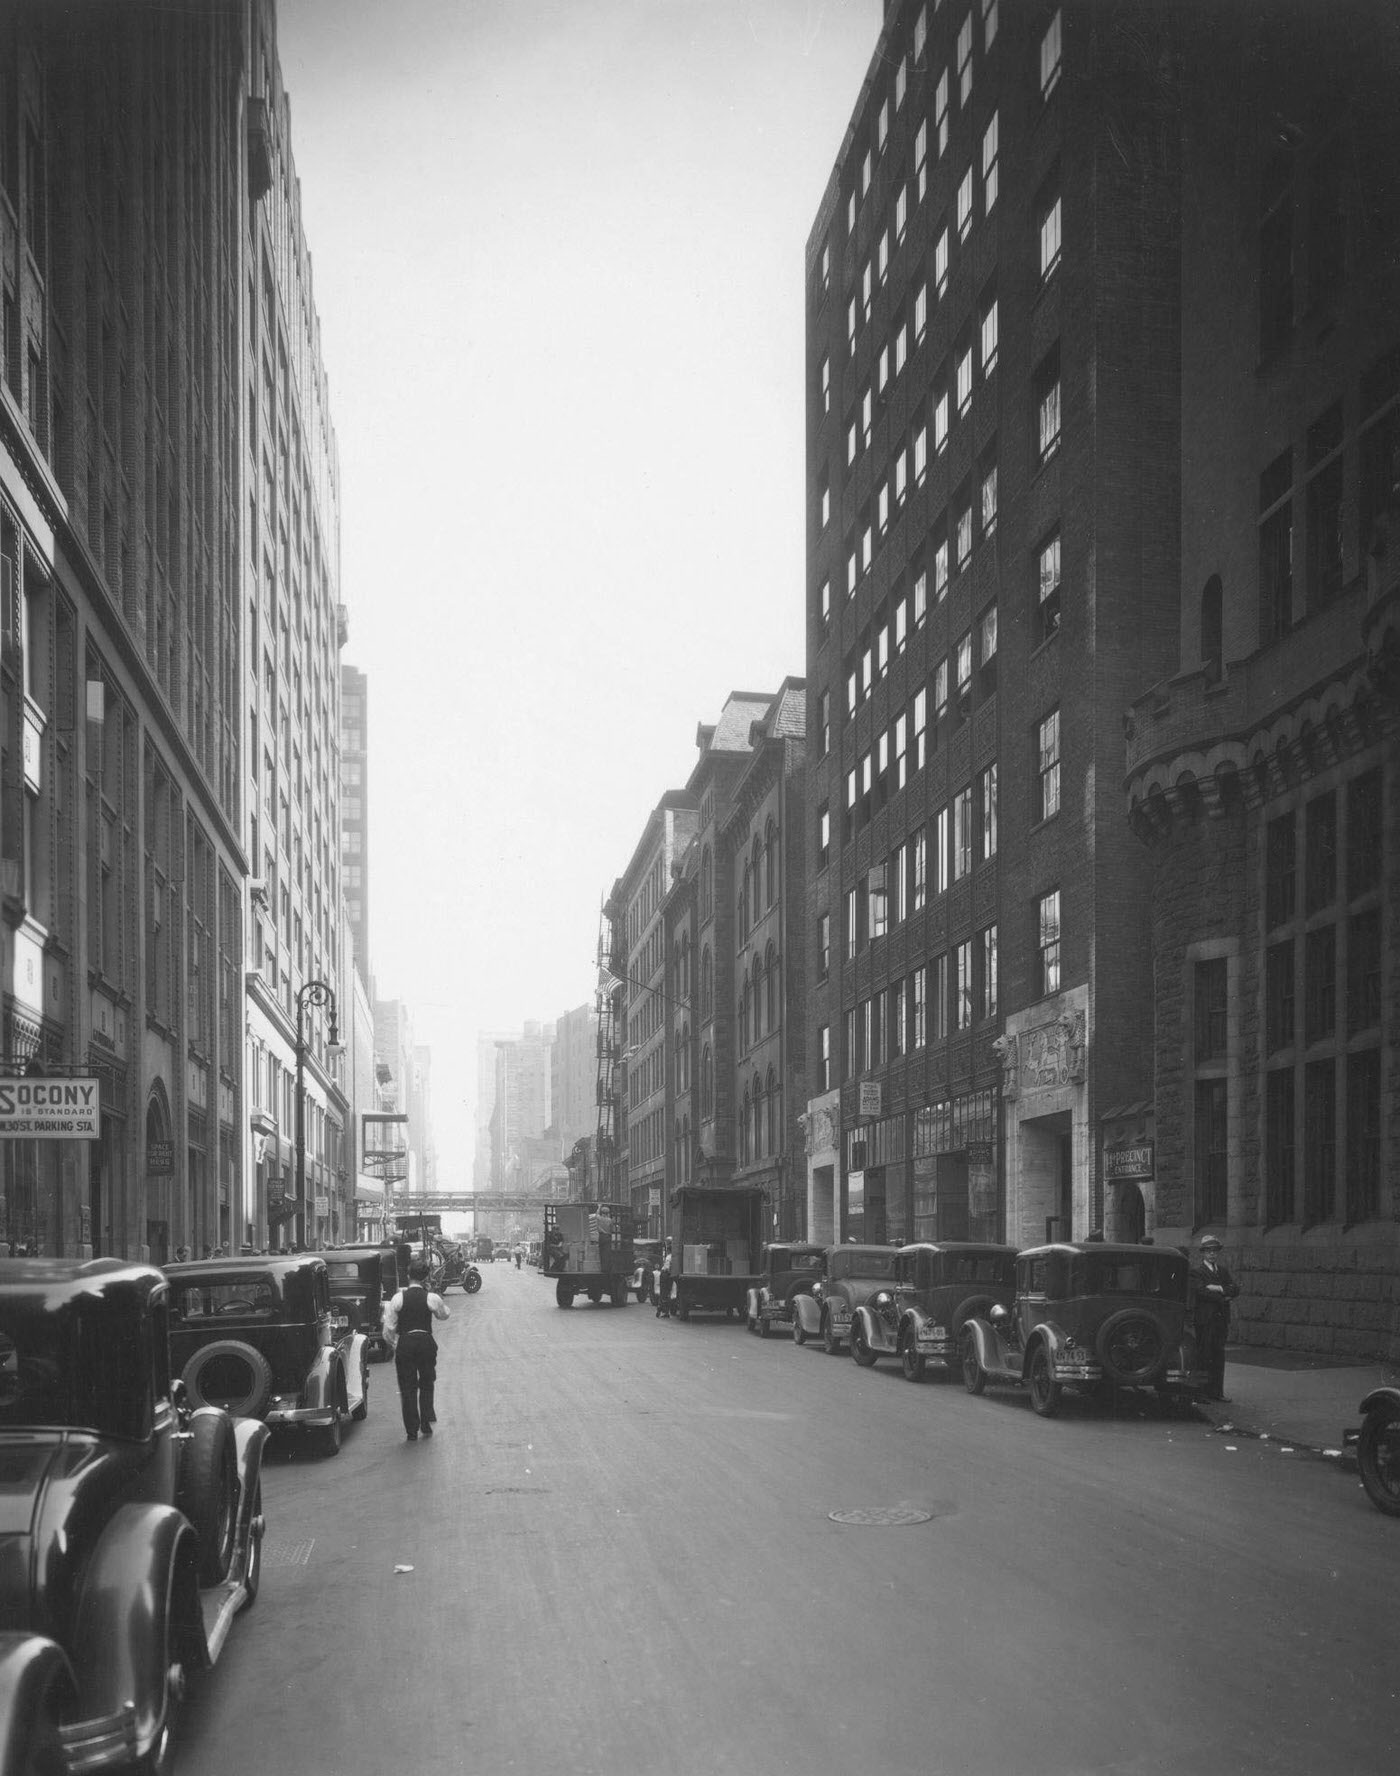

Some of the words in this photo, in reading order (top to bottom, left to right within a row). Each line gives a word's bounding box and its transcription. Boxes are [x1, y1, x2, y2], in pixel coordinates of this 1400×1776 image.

[0, 1085, 94, 1115] SOCONY
[34, 1121, 73, 1131] PARKING
[1116, 1147, 1152, 1165] PRECINCT
